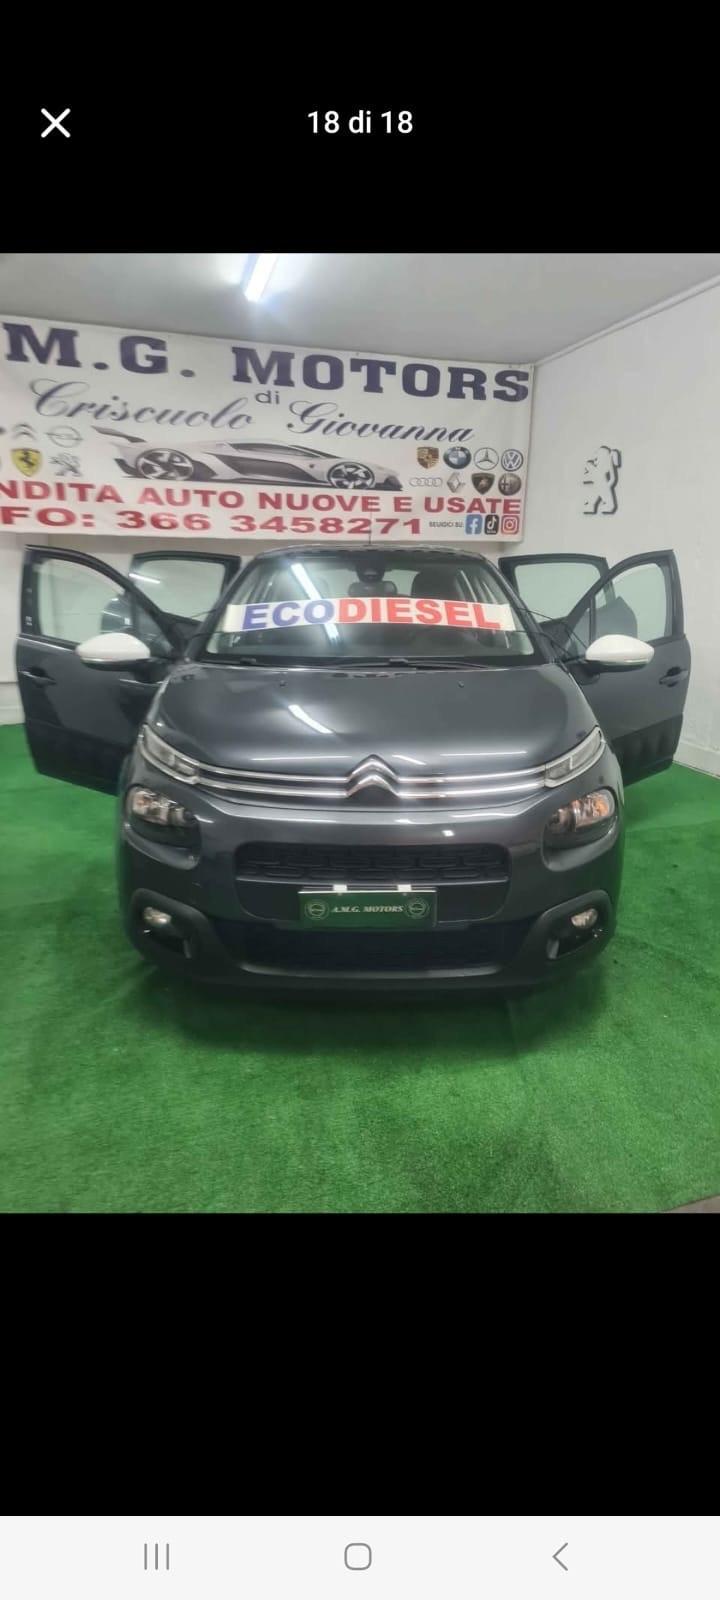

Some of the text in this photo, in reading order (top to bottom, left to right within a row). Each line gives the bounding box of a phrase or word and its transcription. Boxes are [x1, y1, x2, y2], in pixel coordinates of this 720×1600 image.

[231, 346, 529, 402] MOTORS
[29, 378, 474, 442] Criscuolo Giovanna
[255, 390, 280, 405] di
[138, 487, 244, 507] AUTO
[258, 492, 380, 512] NUOVE
[394, 496, 412, 513] E
[424, 496, 521, 515] USATE
[116, 510, 212, 531] 366
[230, 515, 421, 535] 3458271
[242, 598, 501, 630] ECODIESEL
[331, 905, 404, 913] A.M.G. MOTORS
